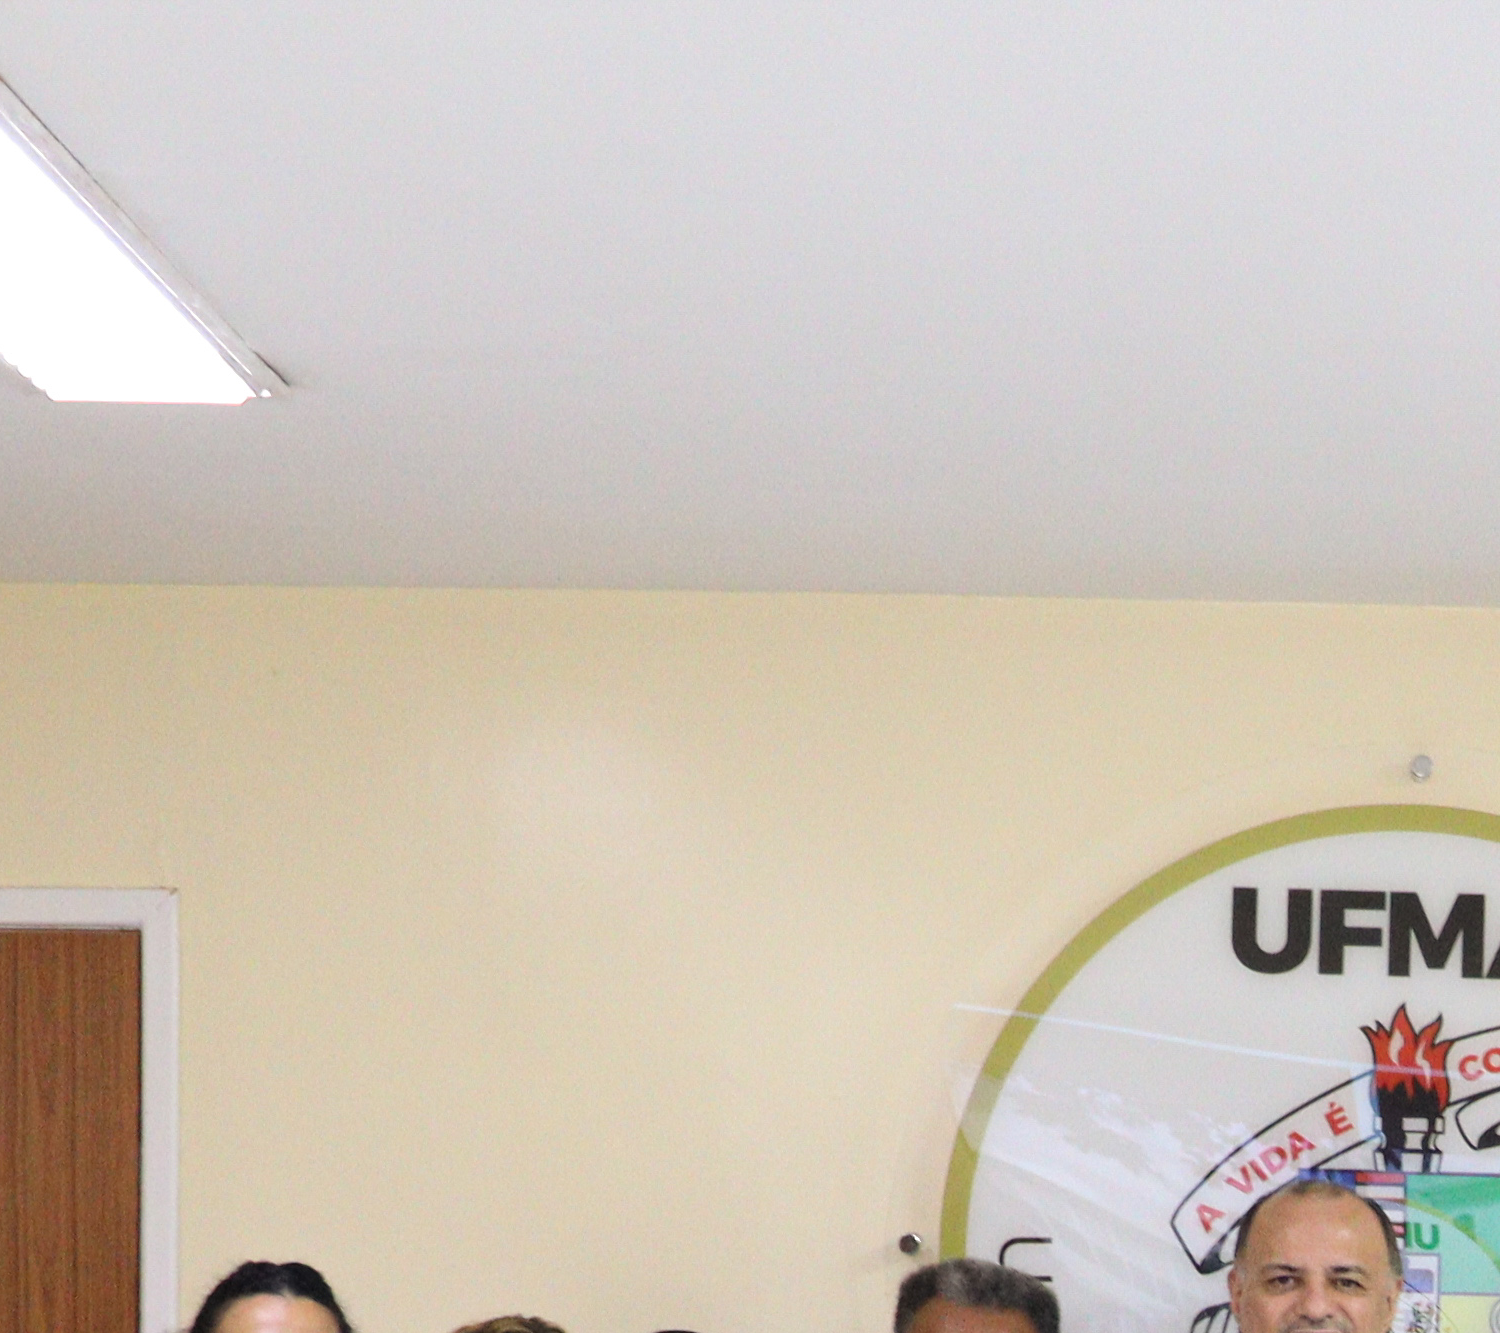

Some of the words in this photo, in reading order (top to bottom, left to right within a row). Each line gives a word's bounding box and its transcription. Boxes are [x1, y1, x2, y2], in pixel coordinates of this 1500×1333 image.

[1196, 1203, 1227, 1233] A
[1224, 1131, 1317, 1194] VIDA
[1324, 1101, 1354, 1136] É
